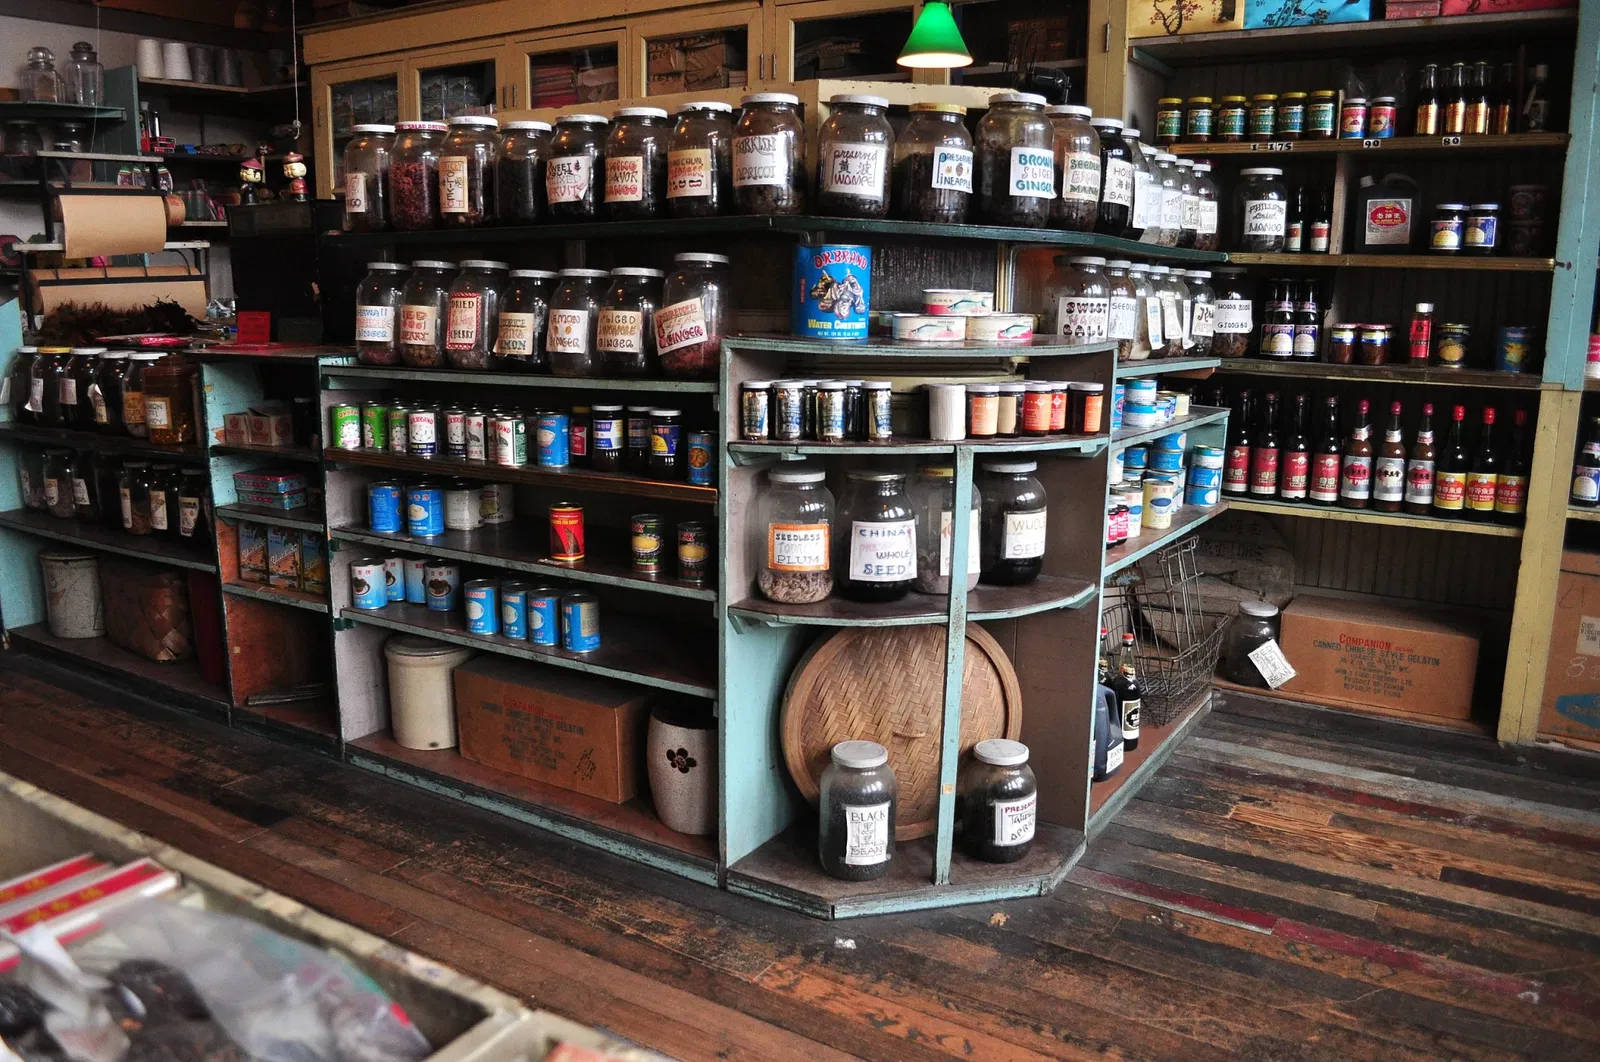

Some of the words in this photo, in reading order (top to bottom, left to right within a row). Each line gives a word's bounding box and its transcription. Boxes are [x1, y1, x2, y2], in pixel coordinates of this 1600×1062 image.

[1444, 137, 1459, 145] 80
[775, 533, 821, 541] SEEDLESS
[859, 528, 906, 537] CHINA
[776, 554, 820, 564] PLUM
[876, 550, 910, 560] WHOLE
[862, 563, 906, 576] SEED
[1339, 633, 1391, 650] COMPANION
[1313, 640, 1341, 651] CANNED
[1345, 644, 1376, 656] CHINESE
[1380, 649, 1405, 660] STYLE
[1407, 654, 1440, 666] GELATIN
[851, 810, 885, 821] BLACK
